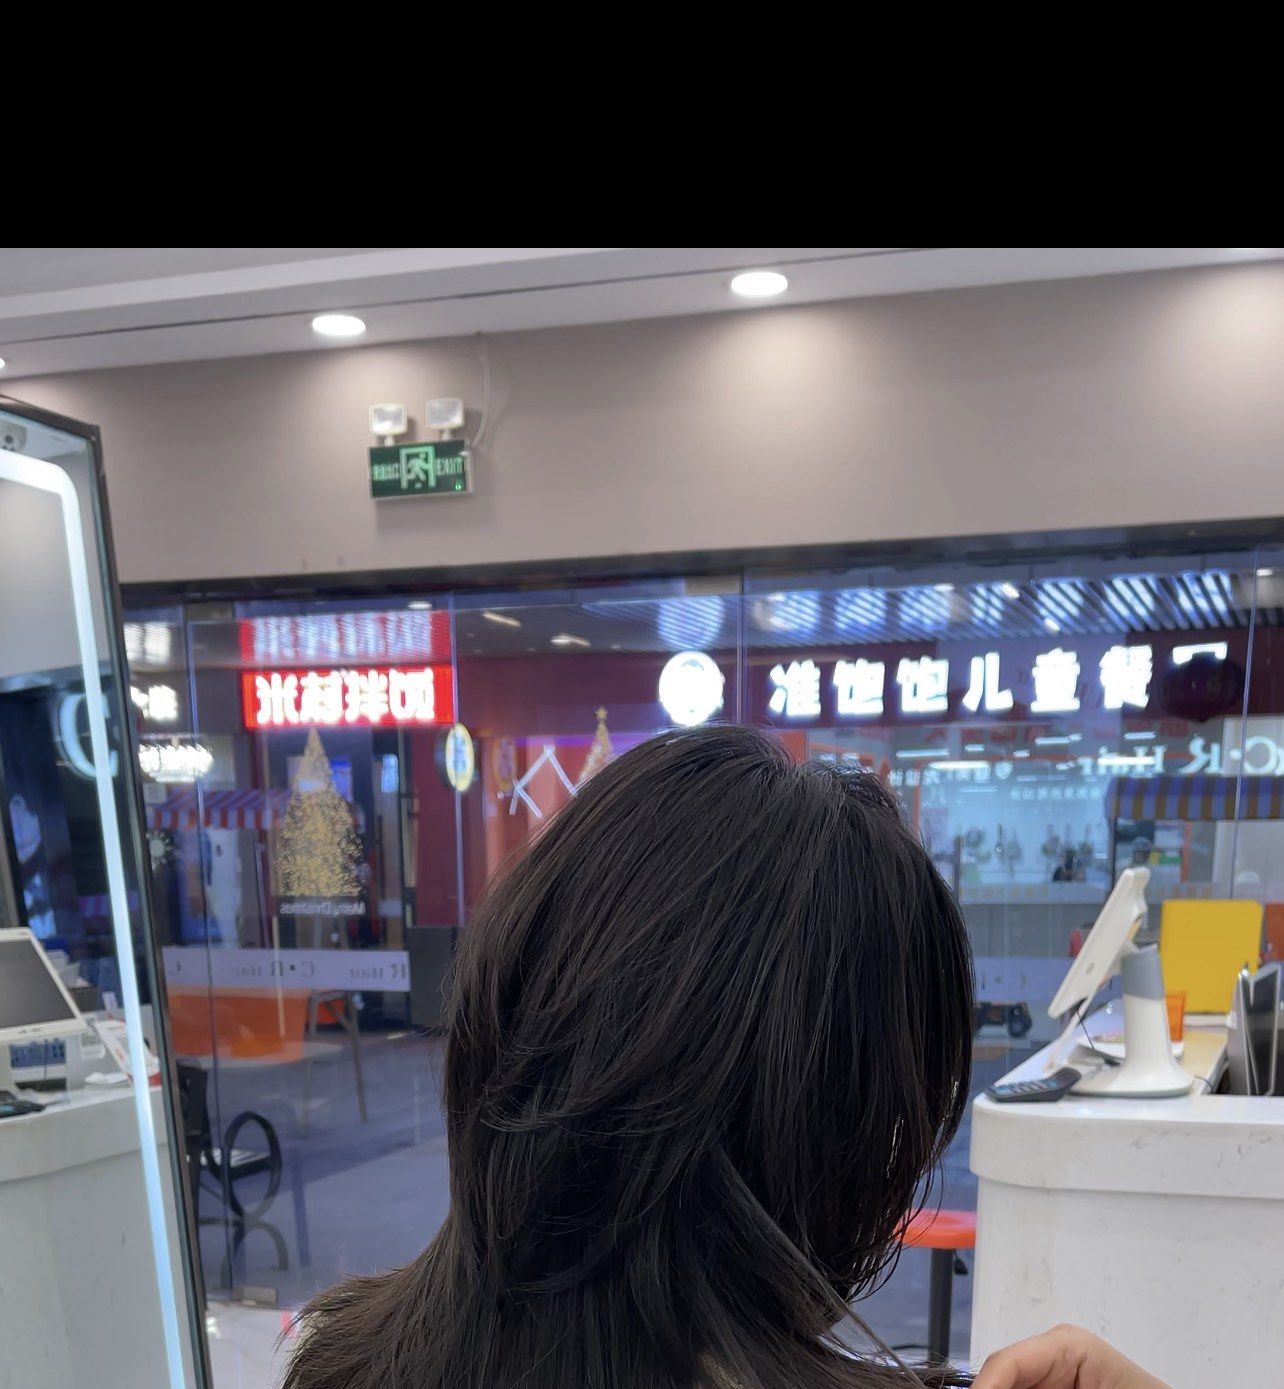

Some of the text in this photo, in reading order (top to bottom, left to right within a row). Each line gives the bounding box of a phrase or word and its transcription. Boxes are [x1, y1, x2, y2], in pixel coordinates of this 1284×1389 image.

[768, 642, 1228, 717] 准饱饱儿童餐
